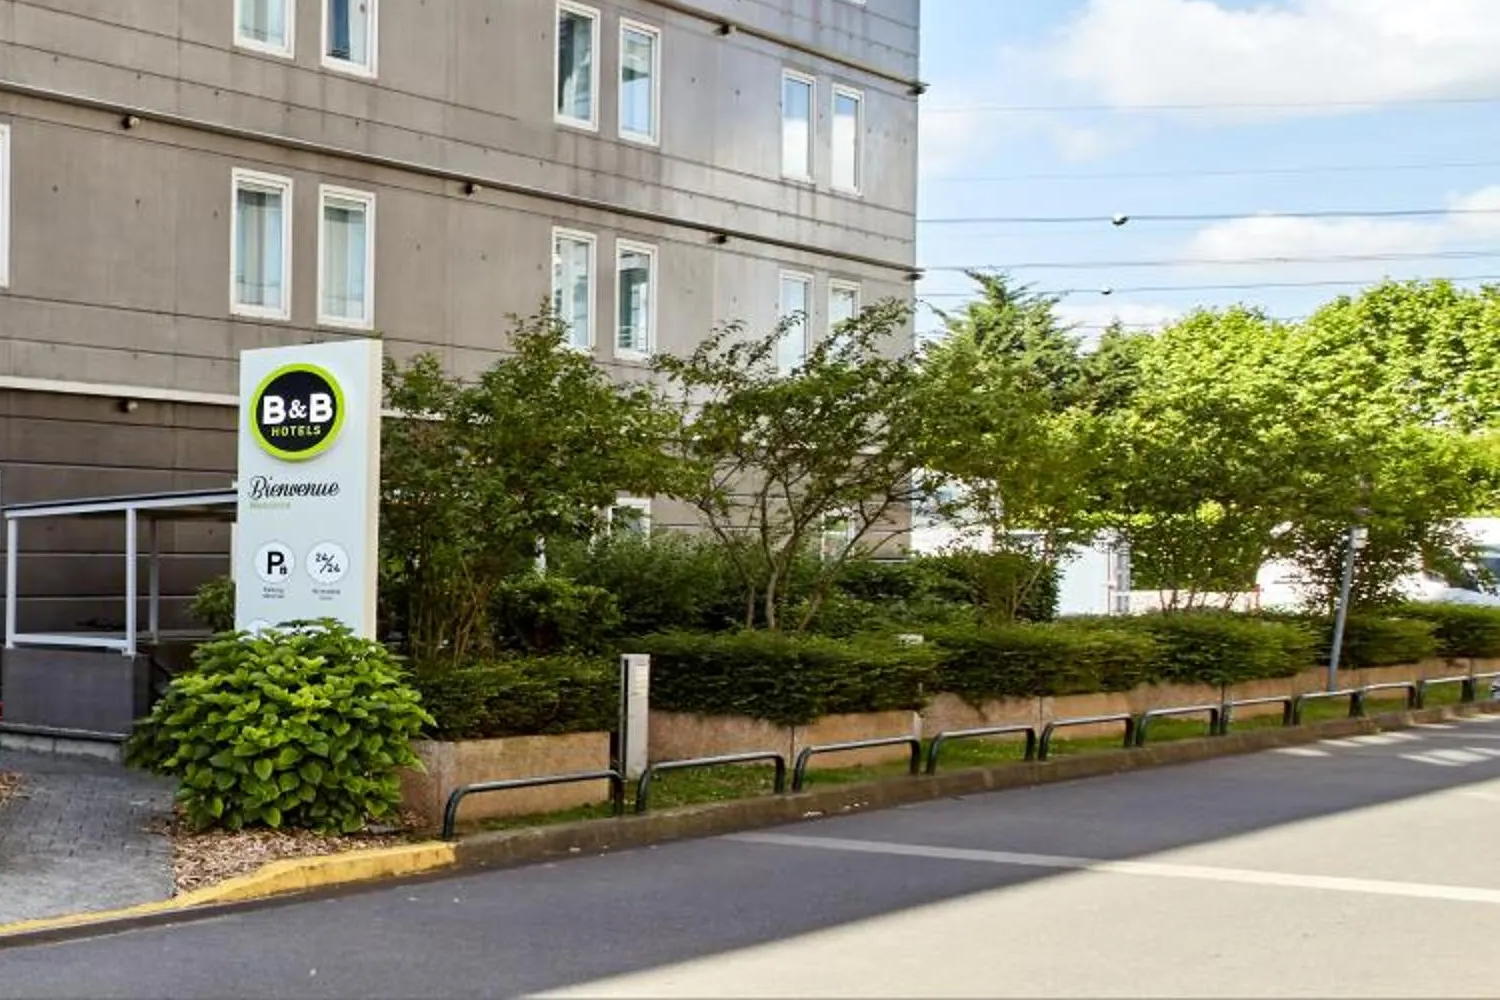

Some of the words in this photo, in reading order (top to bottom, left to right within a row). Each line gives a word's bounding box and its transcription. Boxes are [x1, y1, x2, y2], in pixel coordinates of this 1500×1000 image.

[262, 391, 333, 426] B&B
[271, 425, 322, 438] HOTELS
[247, 475, 341, 501] Bienvenue
